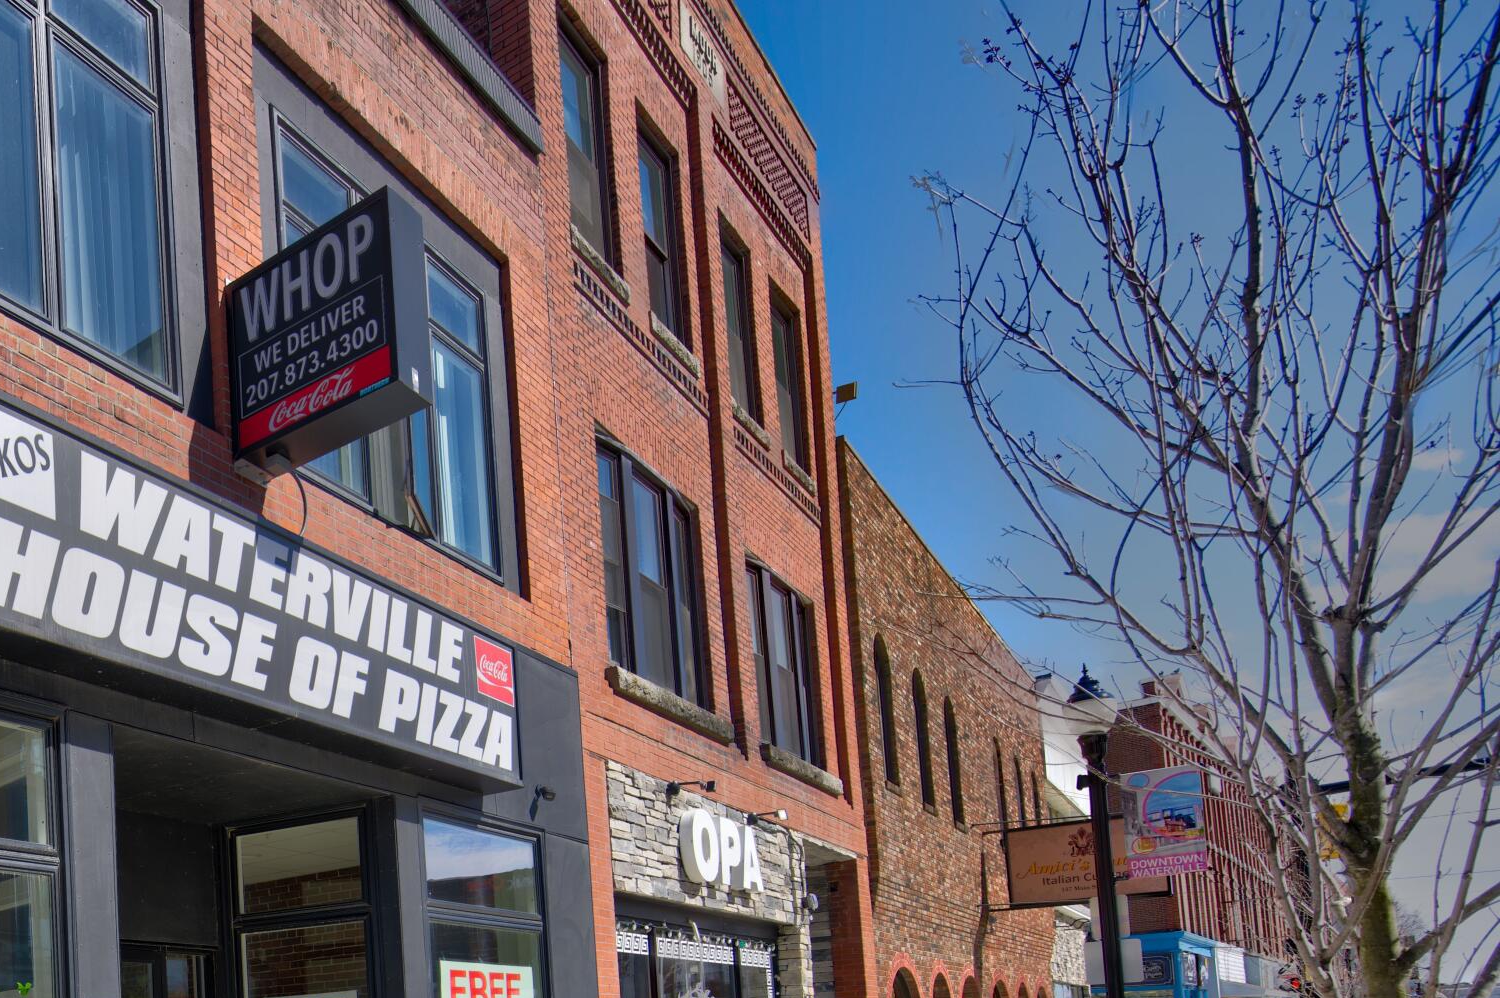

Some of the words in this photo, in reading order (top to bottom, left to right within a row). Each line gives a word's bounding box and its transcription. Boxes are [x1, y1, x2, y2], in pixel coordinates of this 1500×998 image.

[239, 214, 375, 343] WHOP
[246, 318, 379, 408] 207.873.4300
[254, 345, 282, 374] WE
[287, 294, 366, 358] DELIVER
[79, 449, 465, 684] WATERVILLE
[289, 635, 370, 719] OF
[378, 668, 514, 771] PIZZA
[678, 807, 765, 893] OPA
[1016, 858, 1091, 880] Amici's
[1042, 875, 1080, 886] Italian
[1131, 854, 1204, 870] DOWNTOWN
[1132, 862, 1204, 878] WATERVILLE
